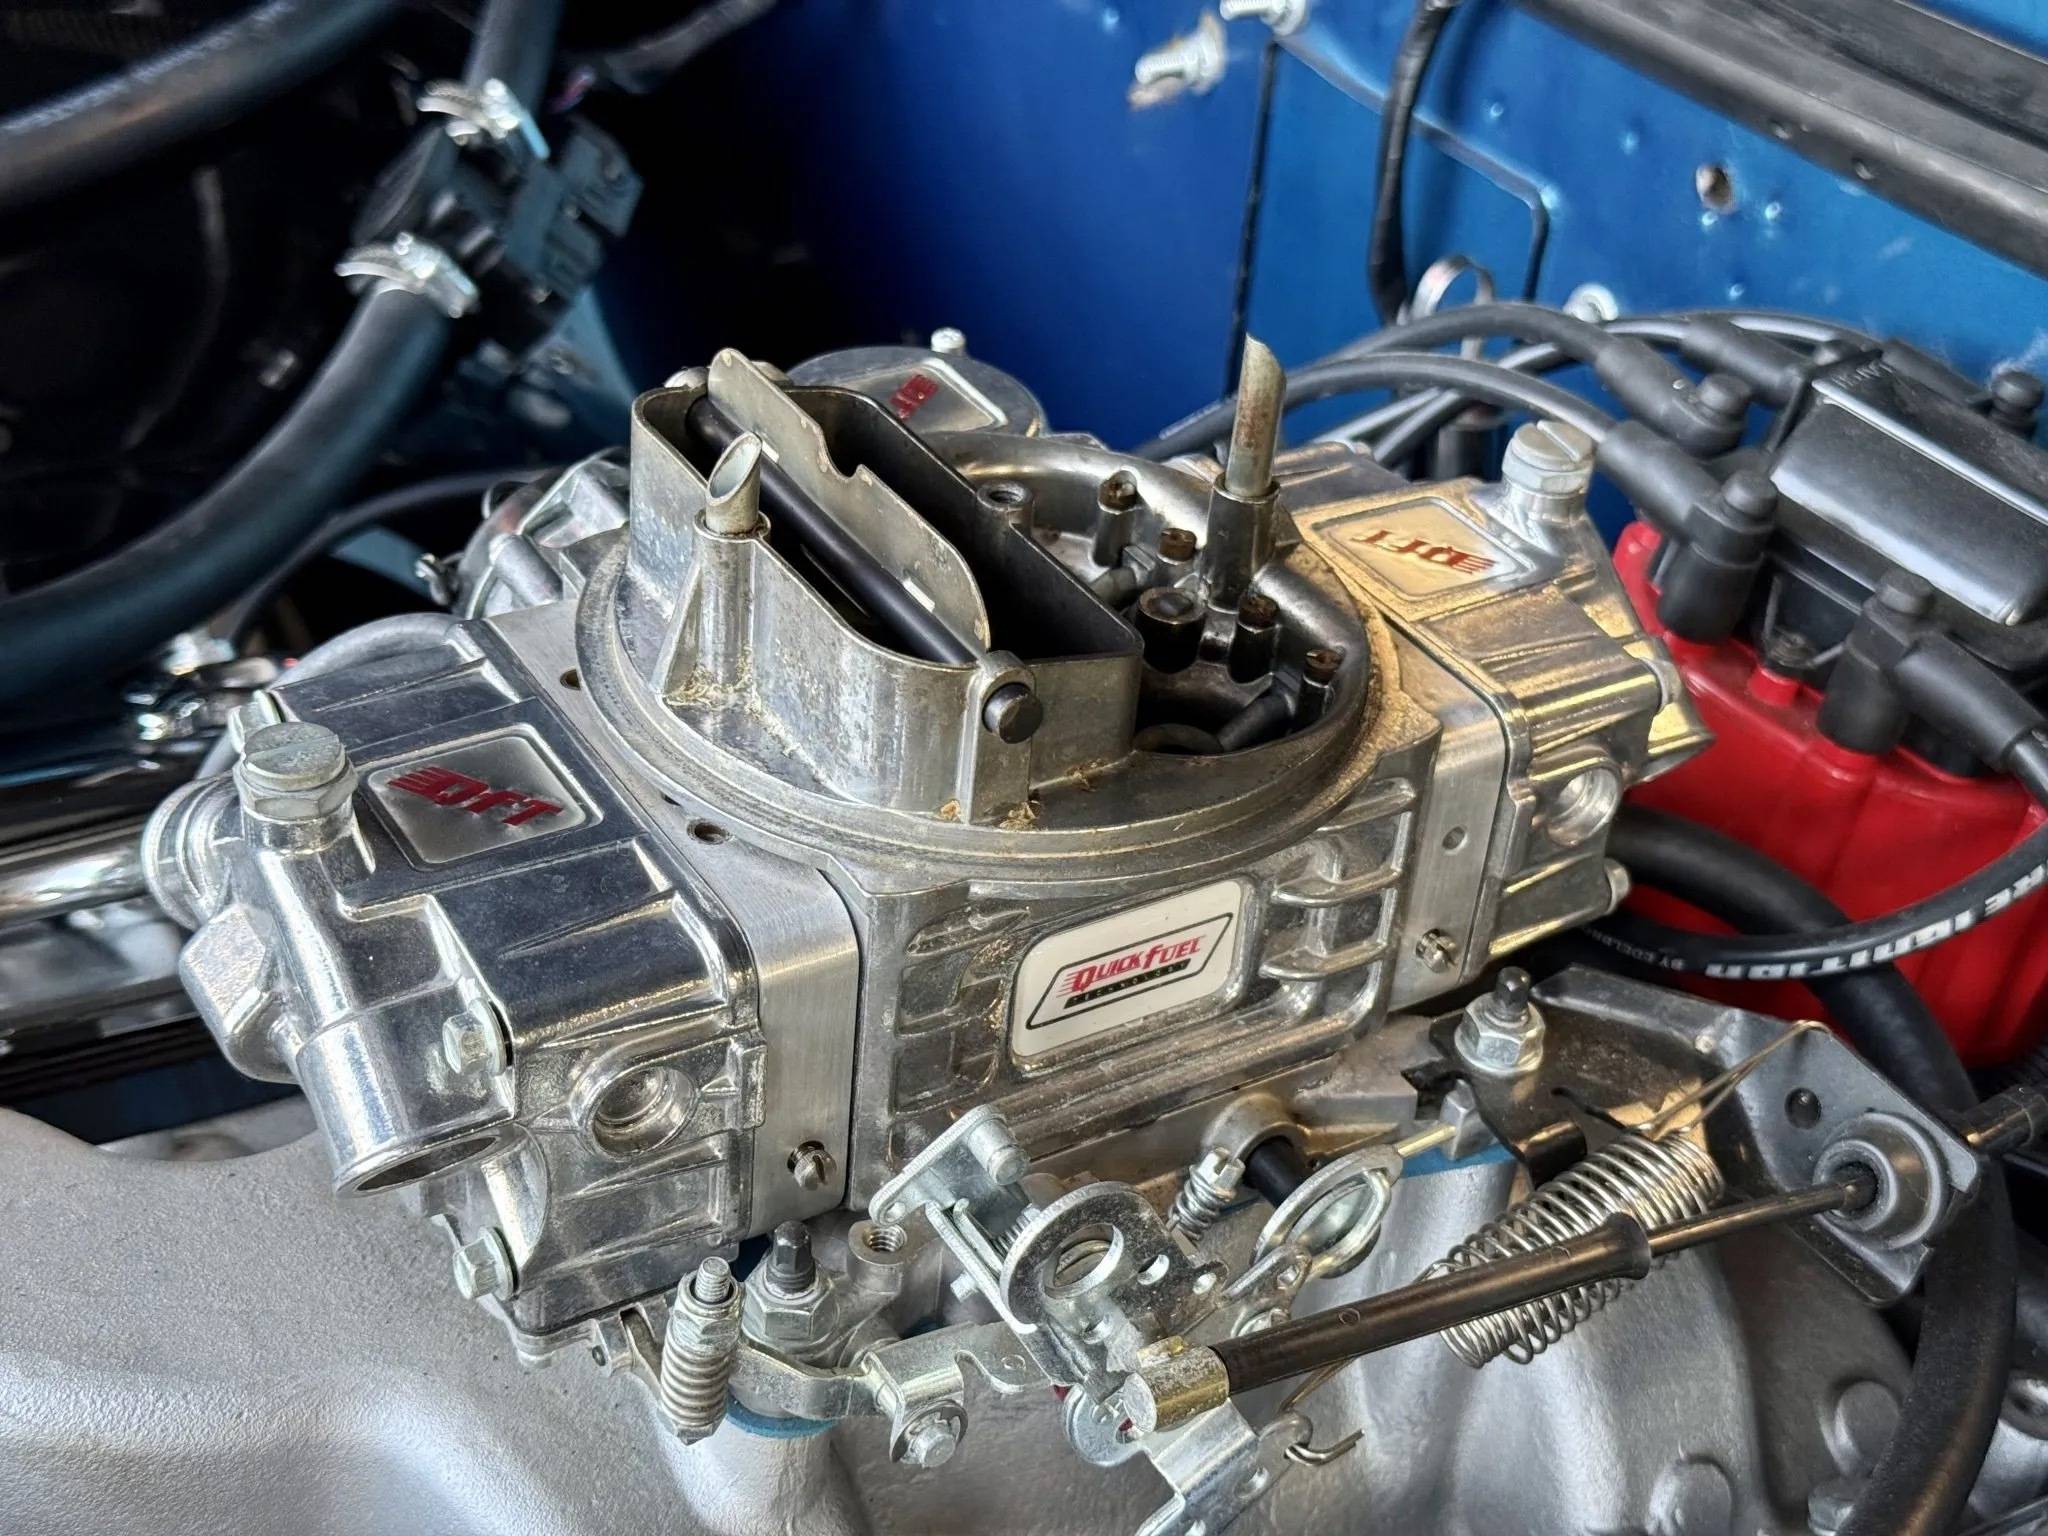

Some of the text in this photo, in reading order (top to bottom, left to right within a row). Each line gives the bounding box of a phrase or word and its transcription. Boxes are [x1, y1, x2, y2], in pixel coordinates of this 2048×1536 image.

[1351, 530, 1498, 575] QFT
[386, 766, 564, 827] QFT
[1984, 860, 2048, 917] RE
